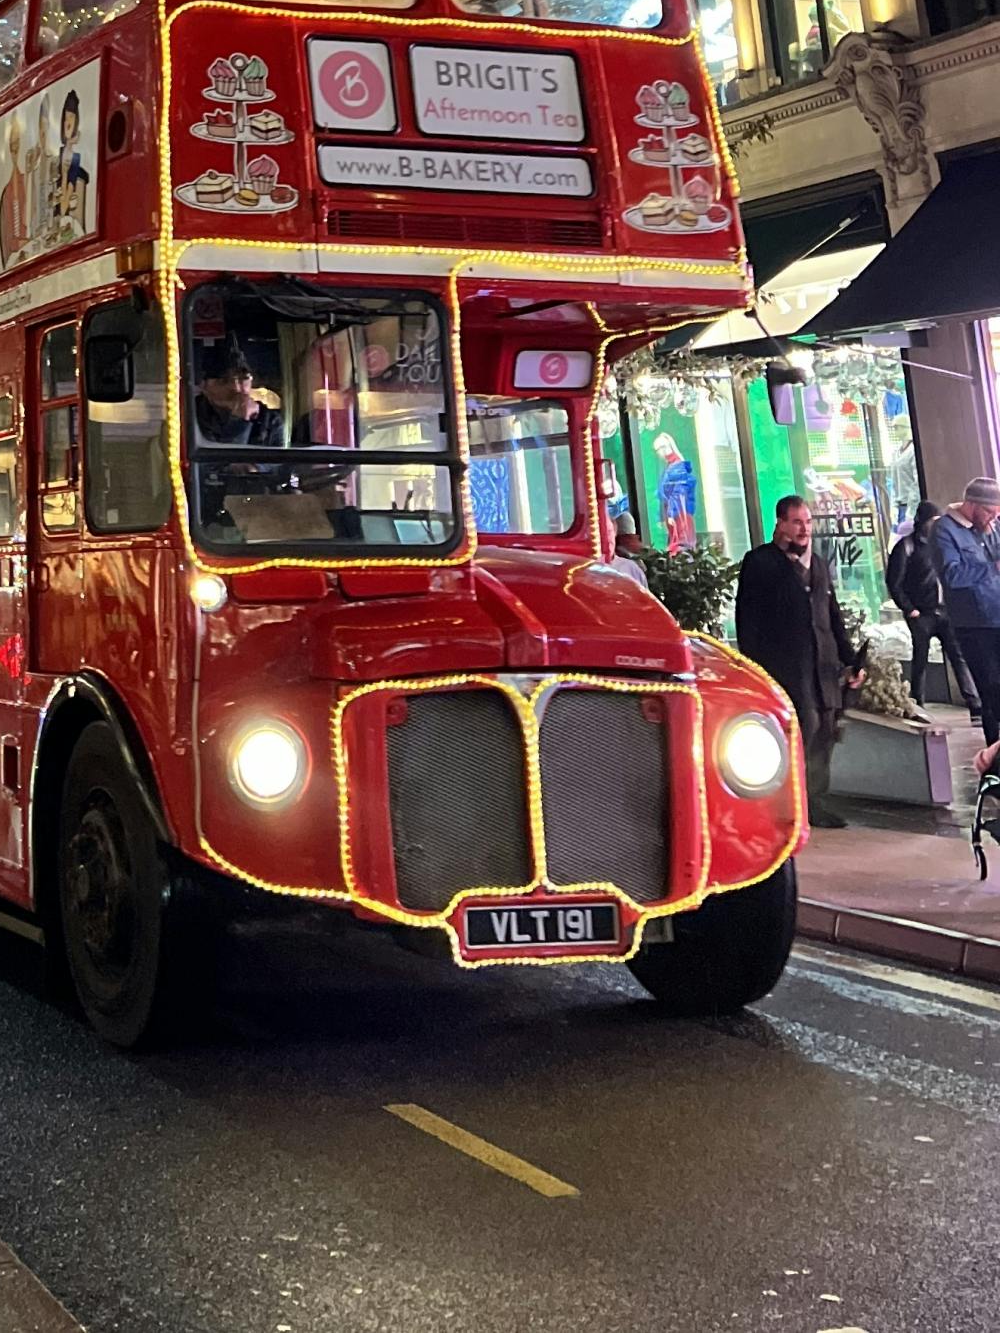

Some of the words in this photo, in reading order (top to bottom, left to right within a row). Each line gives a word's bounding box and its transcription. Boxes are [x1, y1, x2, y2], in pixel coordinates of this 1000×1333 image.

[436, 60, 559, 94] BRIGIT'S
[424, 97, 532, 125] Afternoon
[537, 104, 579, 128] Tea
[336, 156, 579, 187] www.B-BAKERY.com
[842, 517, 873, 533] LEE
[491, 911, 549, 942] VLT
[557, 909, 594, 940] 191
